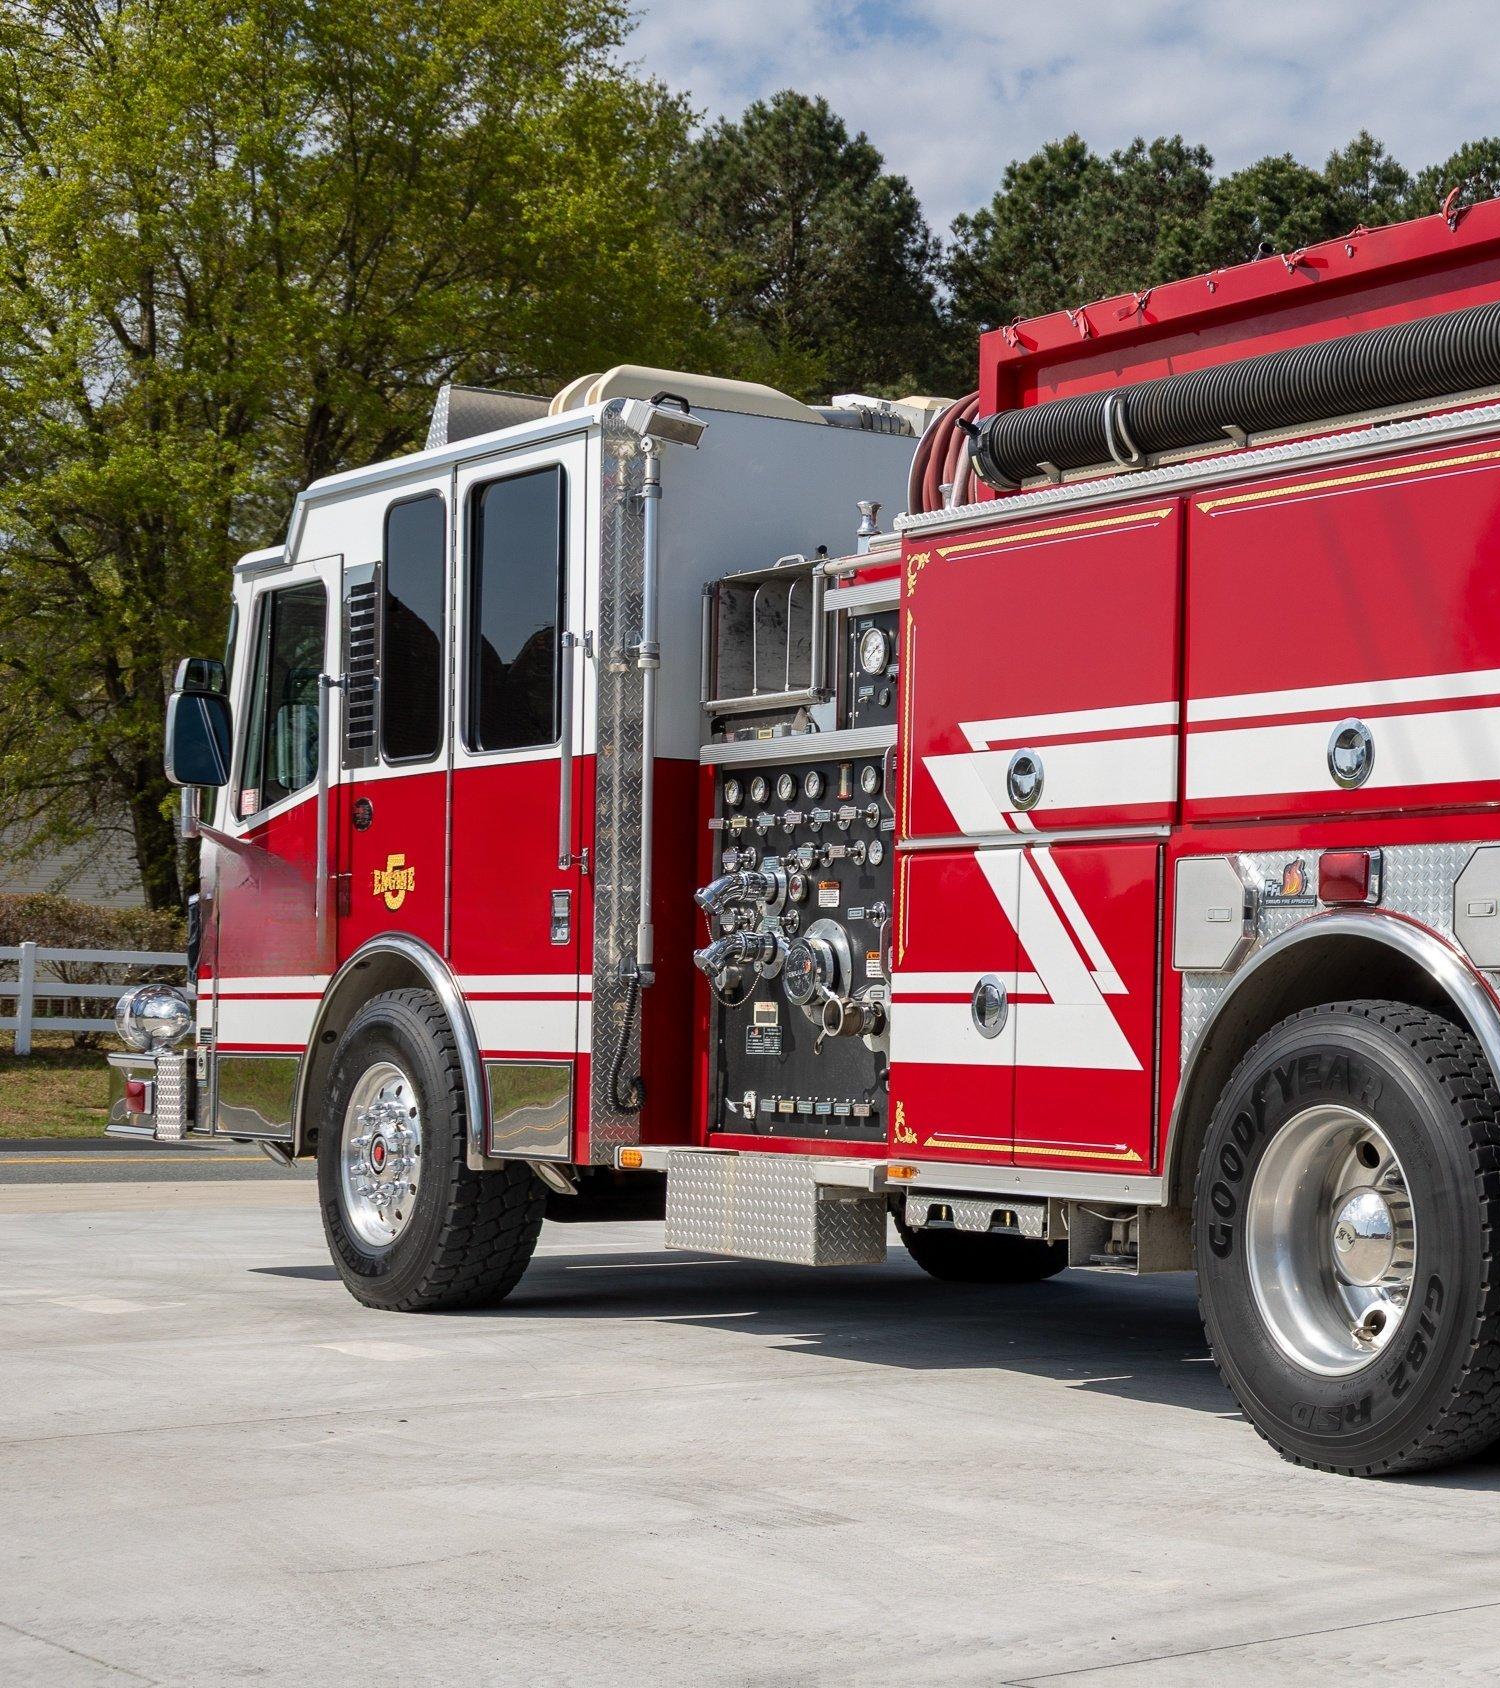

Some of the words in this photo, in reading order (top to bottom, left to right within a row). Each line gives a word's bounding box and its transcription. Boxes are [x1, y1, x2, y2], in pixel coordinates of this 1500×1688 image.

[373, 866, 415, 895] ENGINE
[384, 853, 406, 910] 5
[1208, 1052, 1384, 1260] GOODYEAR
[1386, 1274, 1444, 1399] G182
